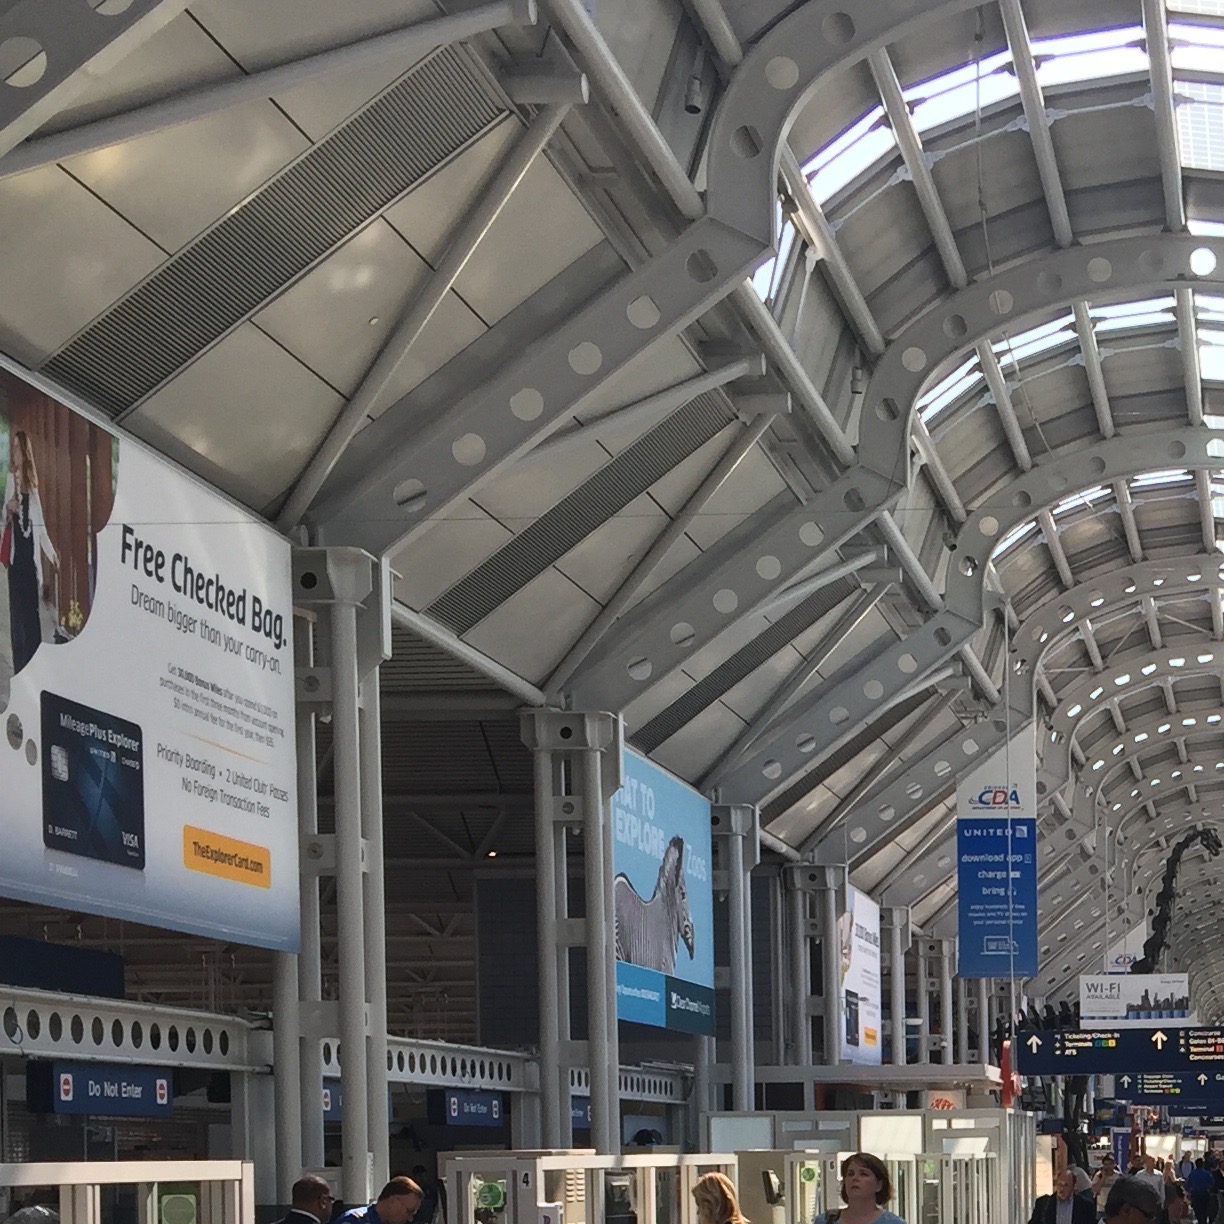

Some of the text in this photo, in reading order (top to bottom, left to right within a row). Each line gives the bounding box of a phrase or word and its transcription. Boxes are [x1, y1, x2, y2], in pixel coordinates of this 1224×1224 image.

[121, 523, 287, 650] Free Checked Bag.
[131, 584, 282, 675] Dream bigger than your carry-on.
[60, 712, 140, 752] MileagePlus Explorer
[157, 743, 184, 768] Priority
[185, 754, 216, 779] Boarding
[226, 768, 231, 783] 2
[232, 771, 252, 791] United
[269, 784, 289, 803] Passes
[182, 777, 270, 819] No Foreign Transaction Fees
[640, 782, 656, 820] TO
[978, 790, 1020, 806] CDA
[121, 831, 140, 849] VISA
[615, 806, 665, 861] EXPLORE
[192, 841, 264, 874] TheExplorerCard.com
[961, 854, 1023, 863] download app
[977, 870, 1007, 880] charge
[982, 887, 1005, 896] bring
[1086, 982, 1121, 993] WI-FI
[88, 1080, 143, 1098] Do Not Enter
[463, 1102, 470, 1113] Do
[477, 1103, 488, 1113] Enter
[522, 1172, 530, 1187] 4
